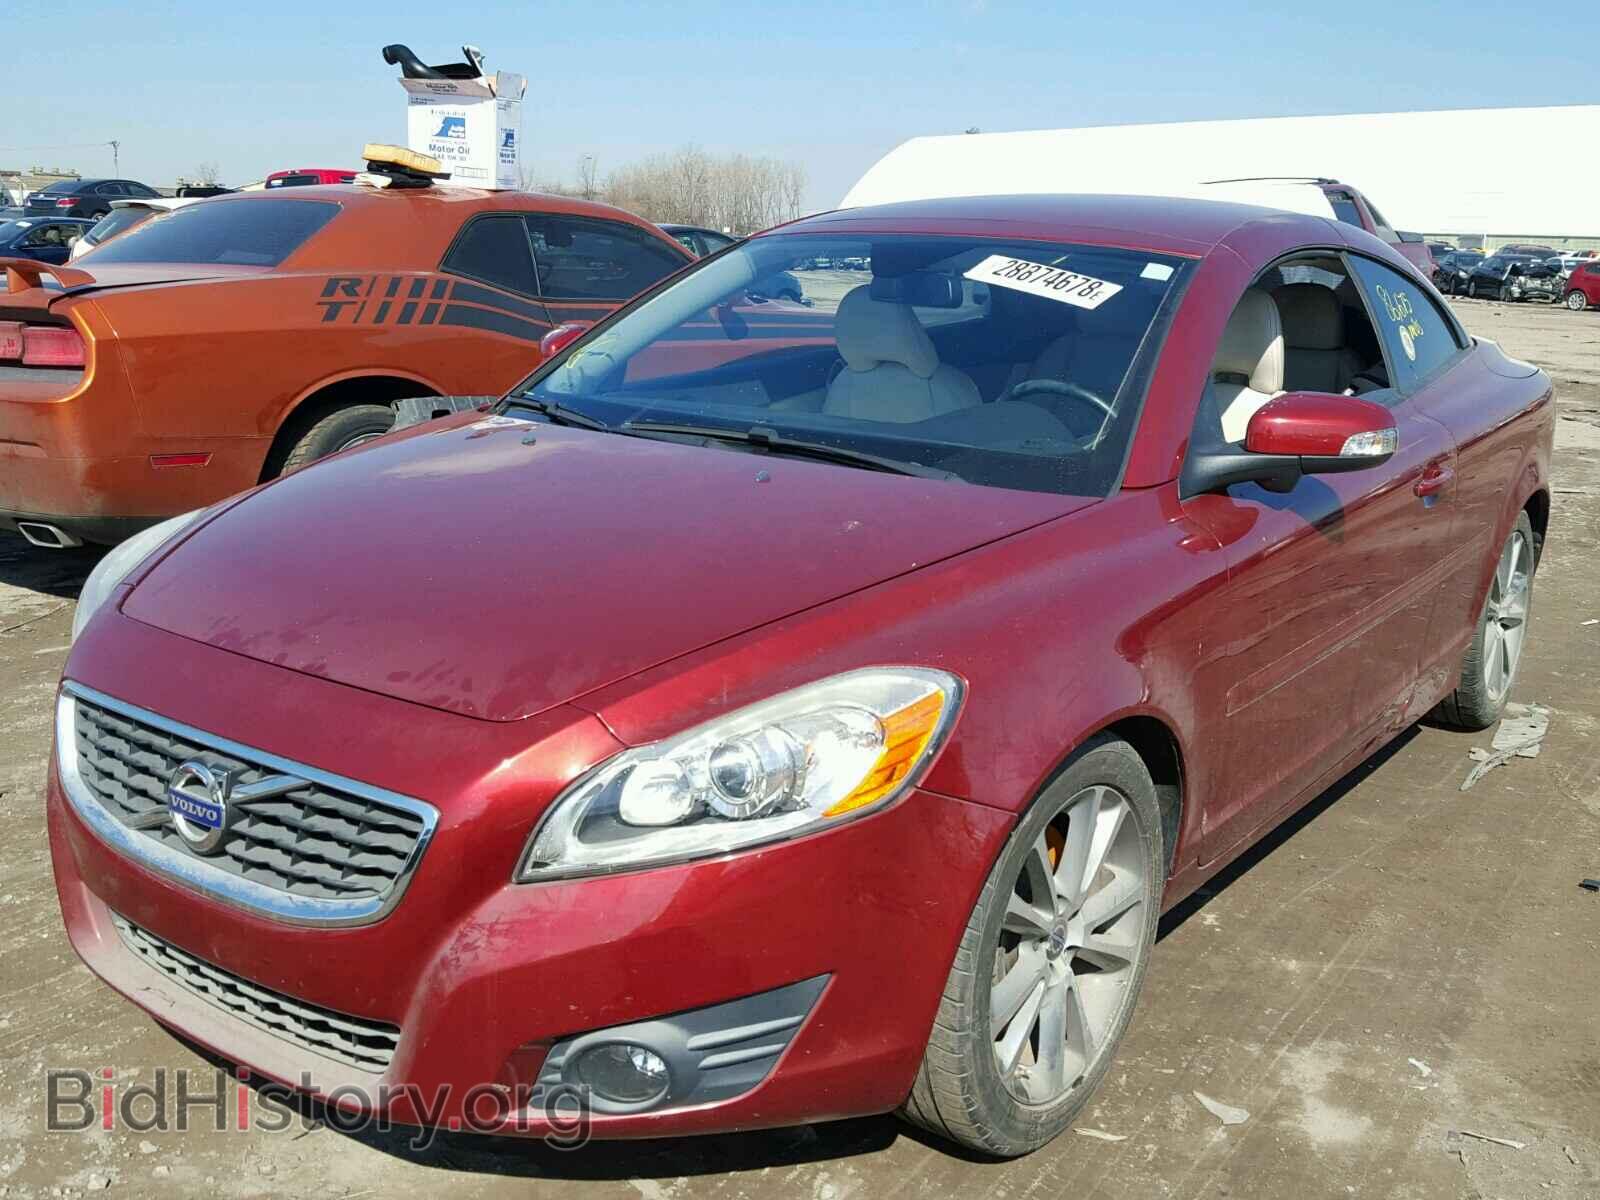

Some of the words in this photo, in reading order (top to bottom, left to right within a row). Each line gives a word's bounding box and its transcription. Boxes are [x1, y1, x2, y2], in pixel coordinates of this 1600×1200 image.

[428, 143, 455, 154] Motor
[457, 146, 470, 155] Oil
[171, 795, 217, 821] VOLVO
